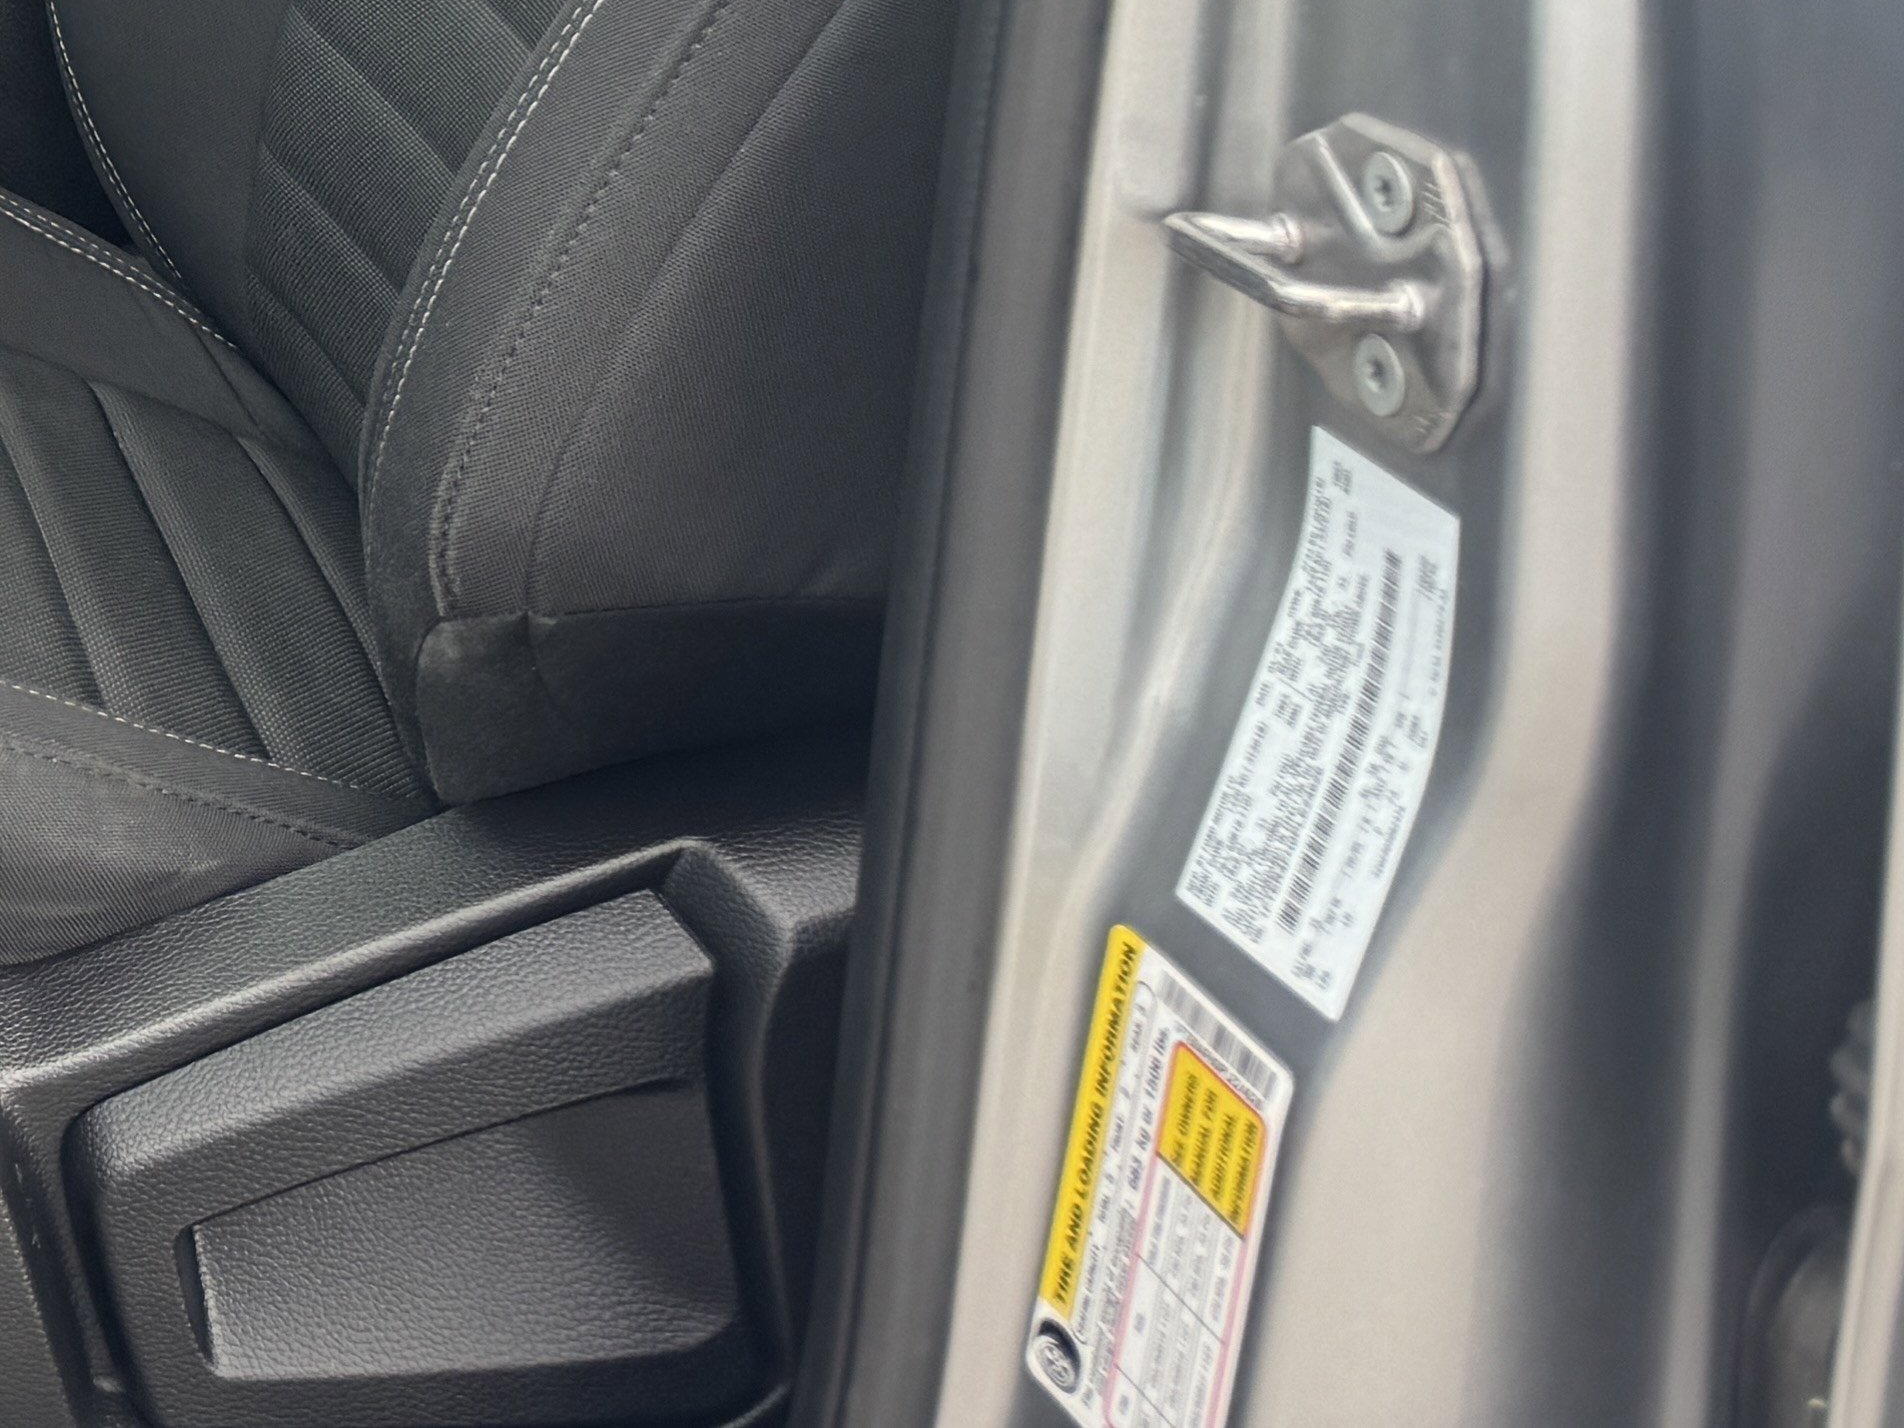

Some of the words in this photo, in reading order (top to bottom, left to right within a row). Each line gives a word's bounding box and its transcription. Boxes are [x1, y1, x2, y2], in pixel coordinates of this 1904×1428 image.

[1096, 941, 1137, 1096] INFORMATION
[1074, 1101, 1103, 1199] LOADING
[1064, 1202, 1085, 1252] AND
[1055, 1254, 1075, 1305] TIRE
